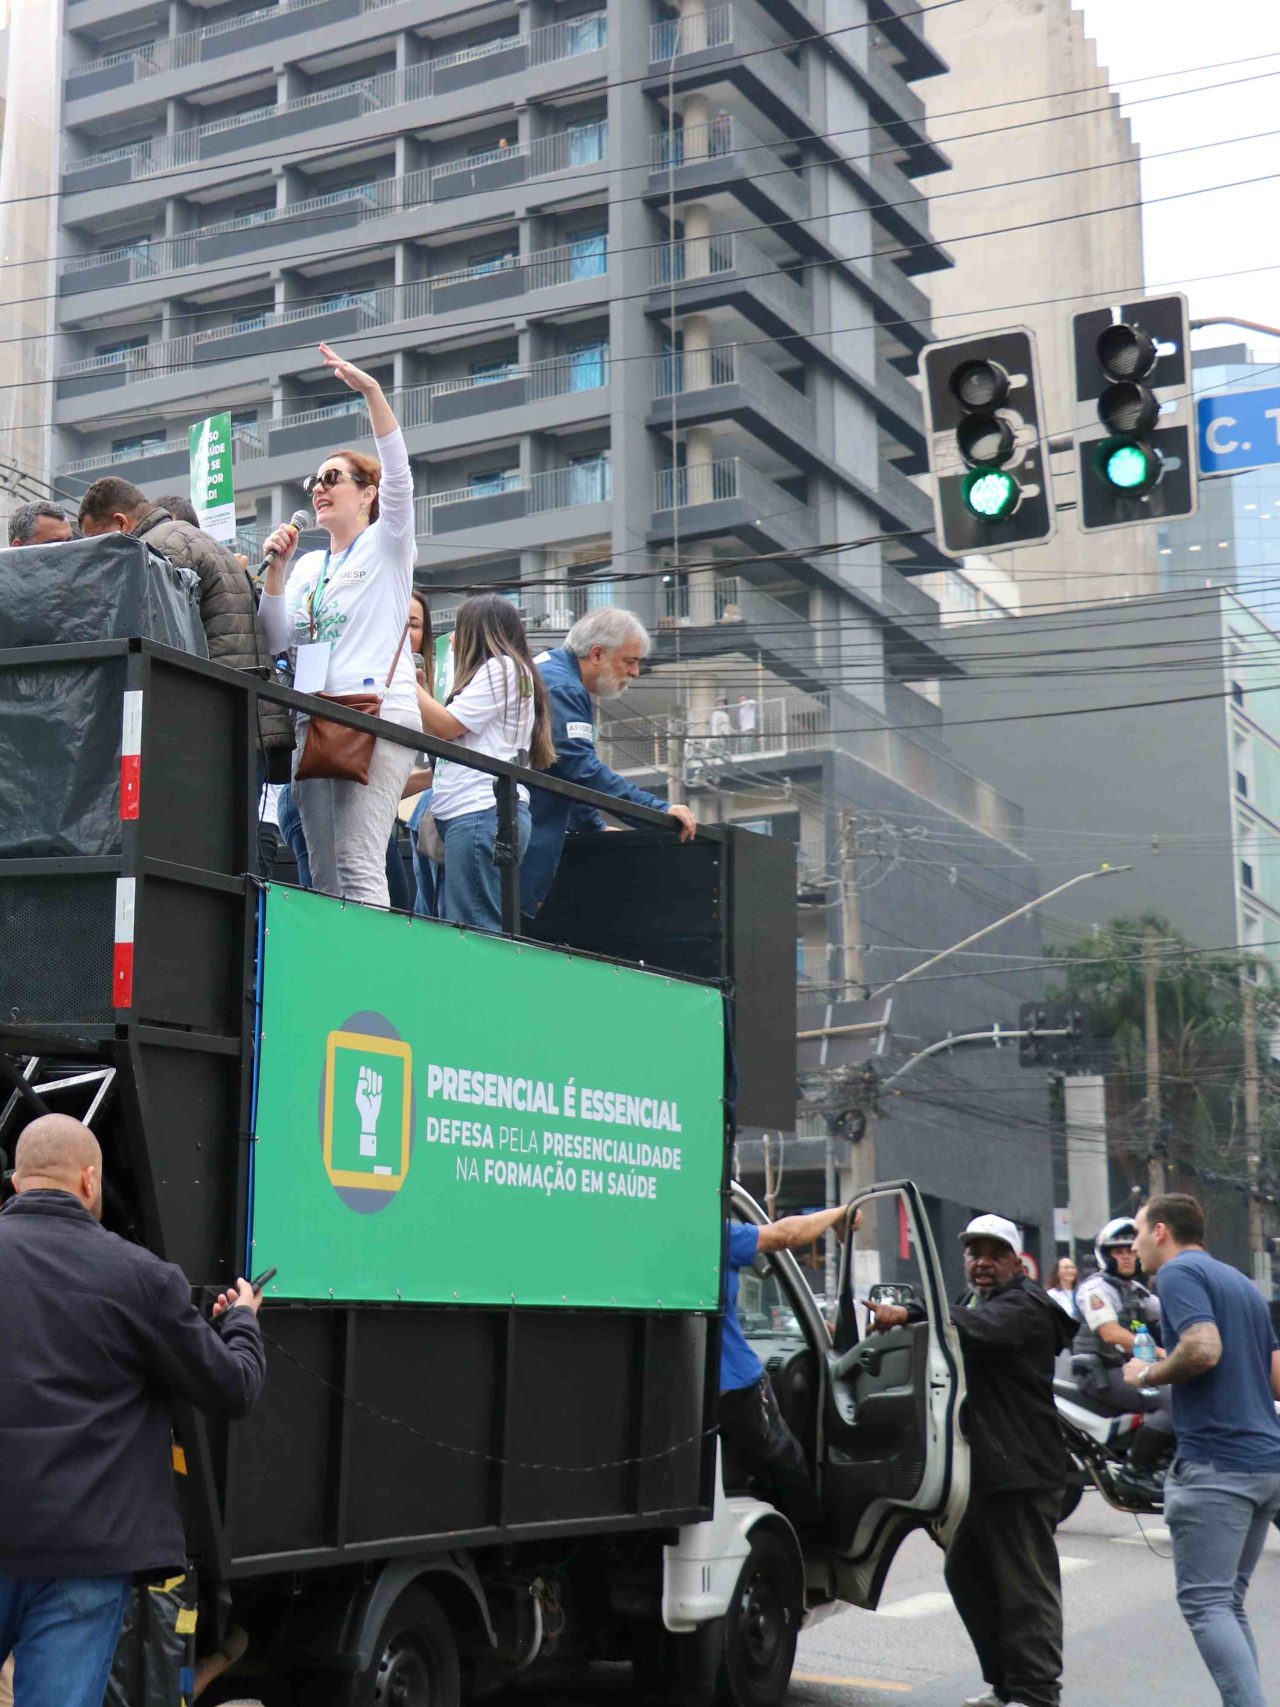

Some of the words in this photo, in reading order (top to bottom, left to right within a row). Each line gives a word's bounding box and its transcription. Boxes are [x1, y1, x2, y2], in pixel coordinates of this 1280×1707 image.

[1205, 416, 1252, 455] C.
[211, 459, 220, 470] SE
[427, 1064, 559, 1115] PRESENCIAL
[563, 1077, 577, 1117] É
[581, 1088, 682, 1132] ESSENCIAL
[426, 1117, 494, 1150] DEFESA
[499, 1127, 539, 1154] PELA
[543, 1131, 682, 1170] PRESENCIALIDADE
[456, 1156, 480, 1183] NA
[484, 1158, 577, 1196] FORMAÇÃO
[581, 1169, 604, 1194] EM
[607, 1168, 657, 1200] SAÚDE
